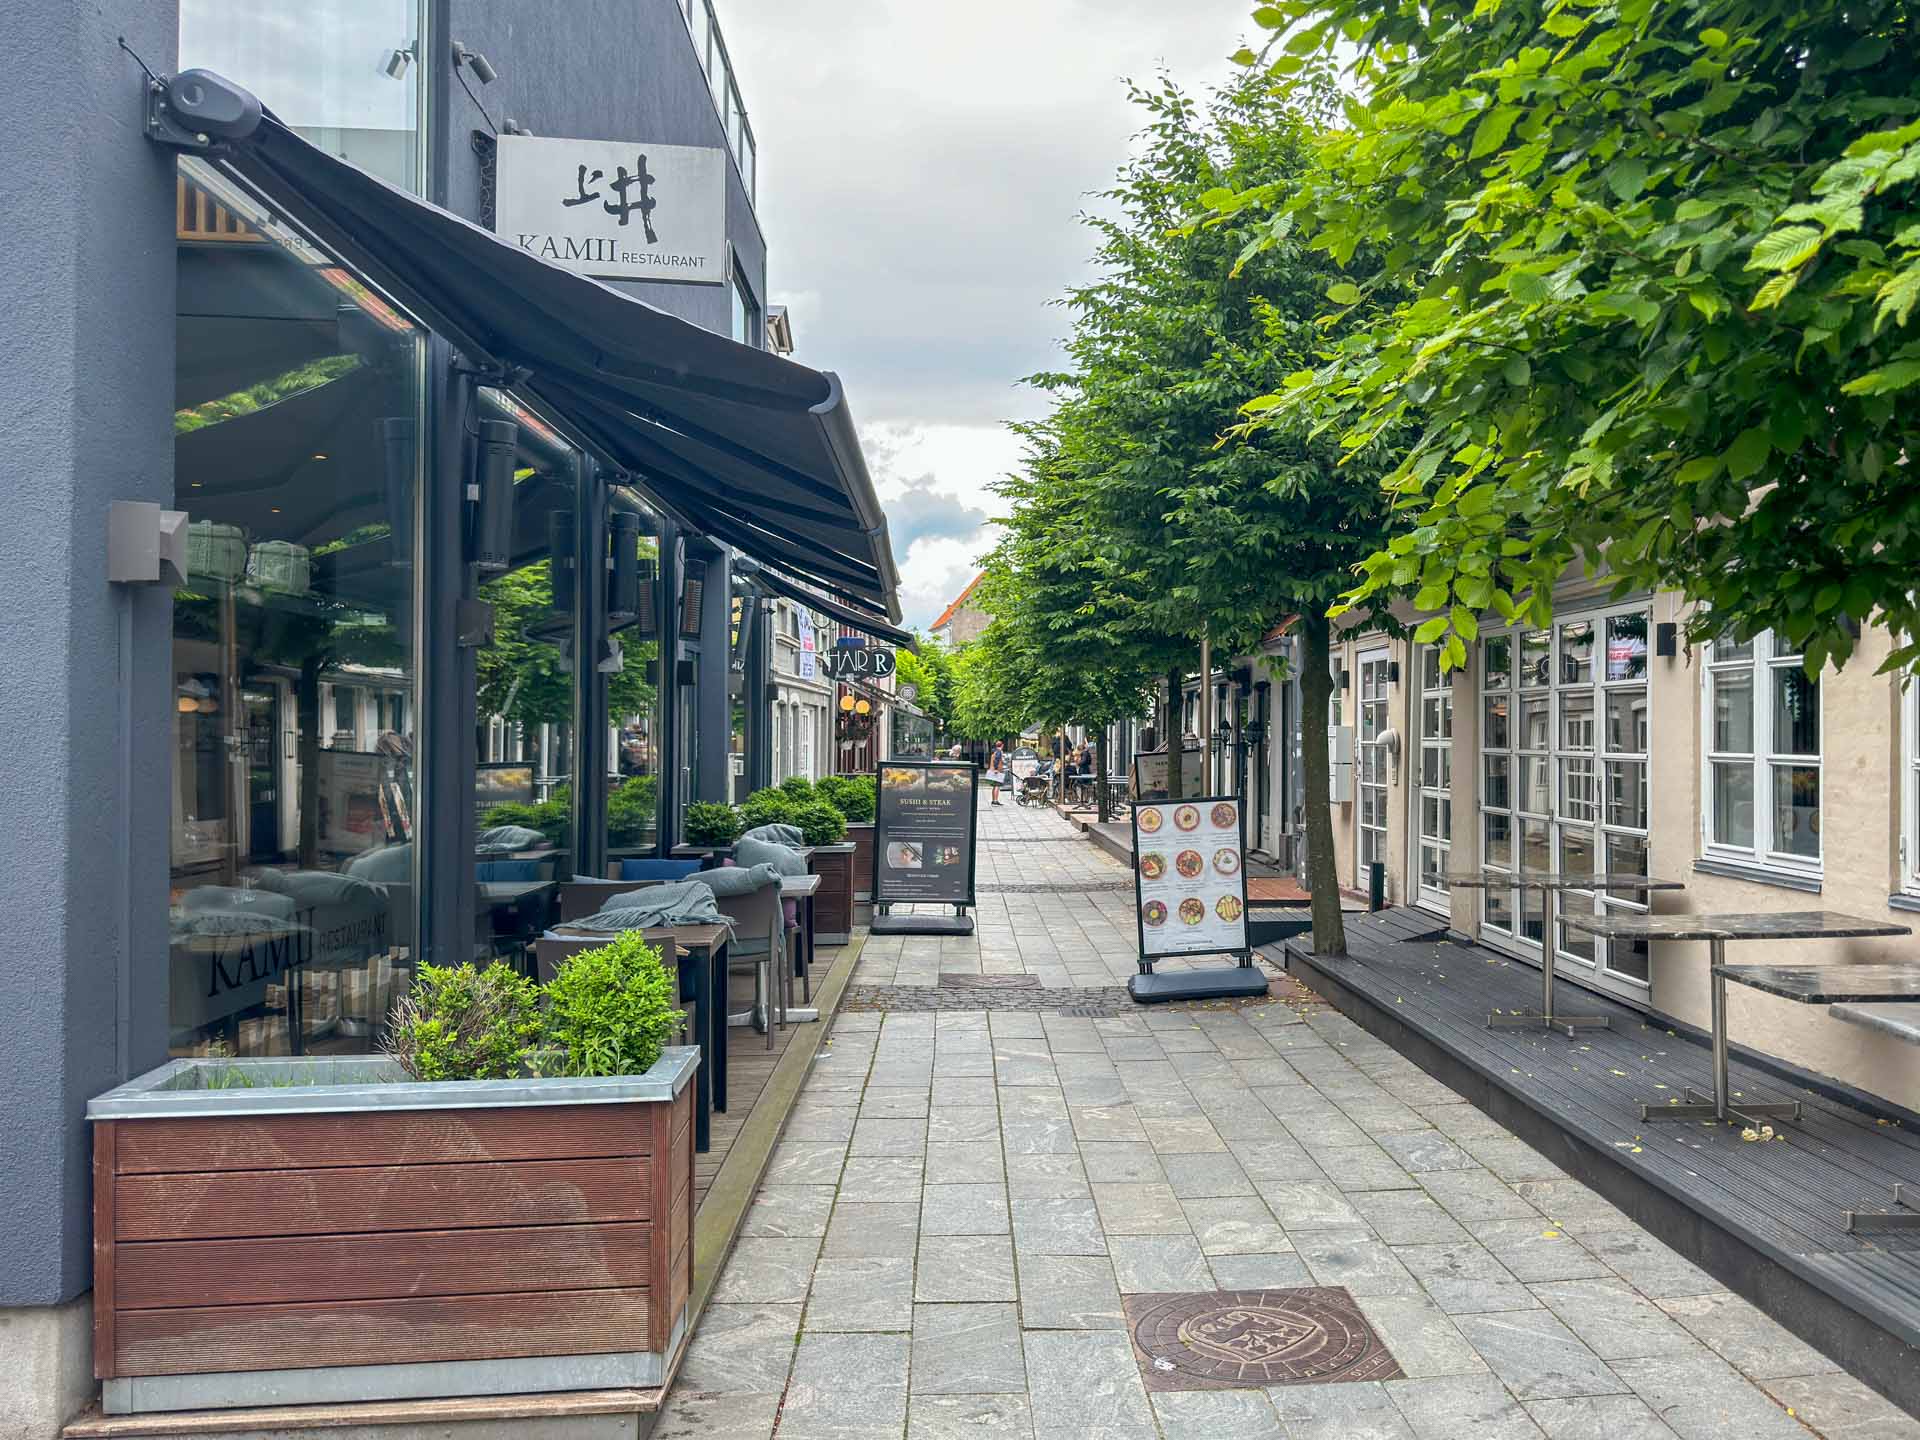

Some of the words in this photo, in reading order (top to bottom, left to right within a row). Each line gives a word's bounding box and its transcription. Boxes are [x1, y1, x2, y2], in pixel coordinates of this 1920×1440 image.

[517, 233, 617, 263] KAMII
[622, 252, 705, 268] RESTAURANT
[828, 649, 869, 672] HAIR
[873, 653, 888, 672] R
